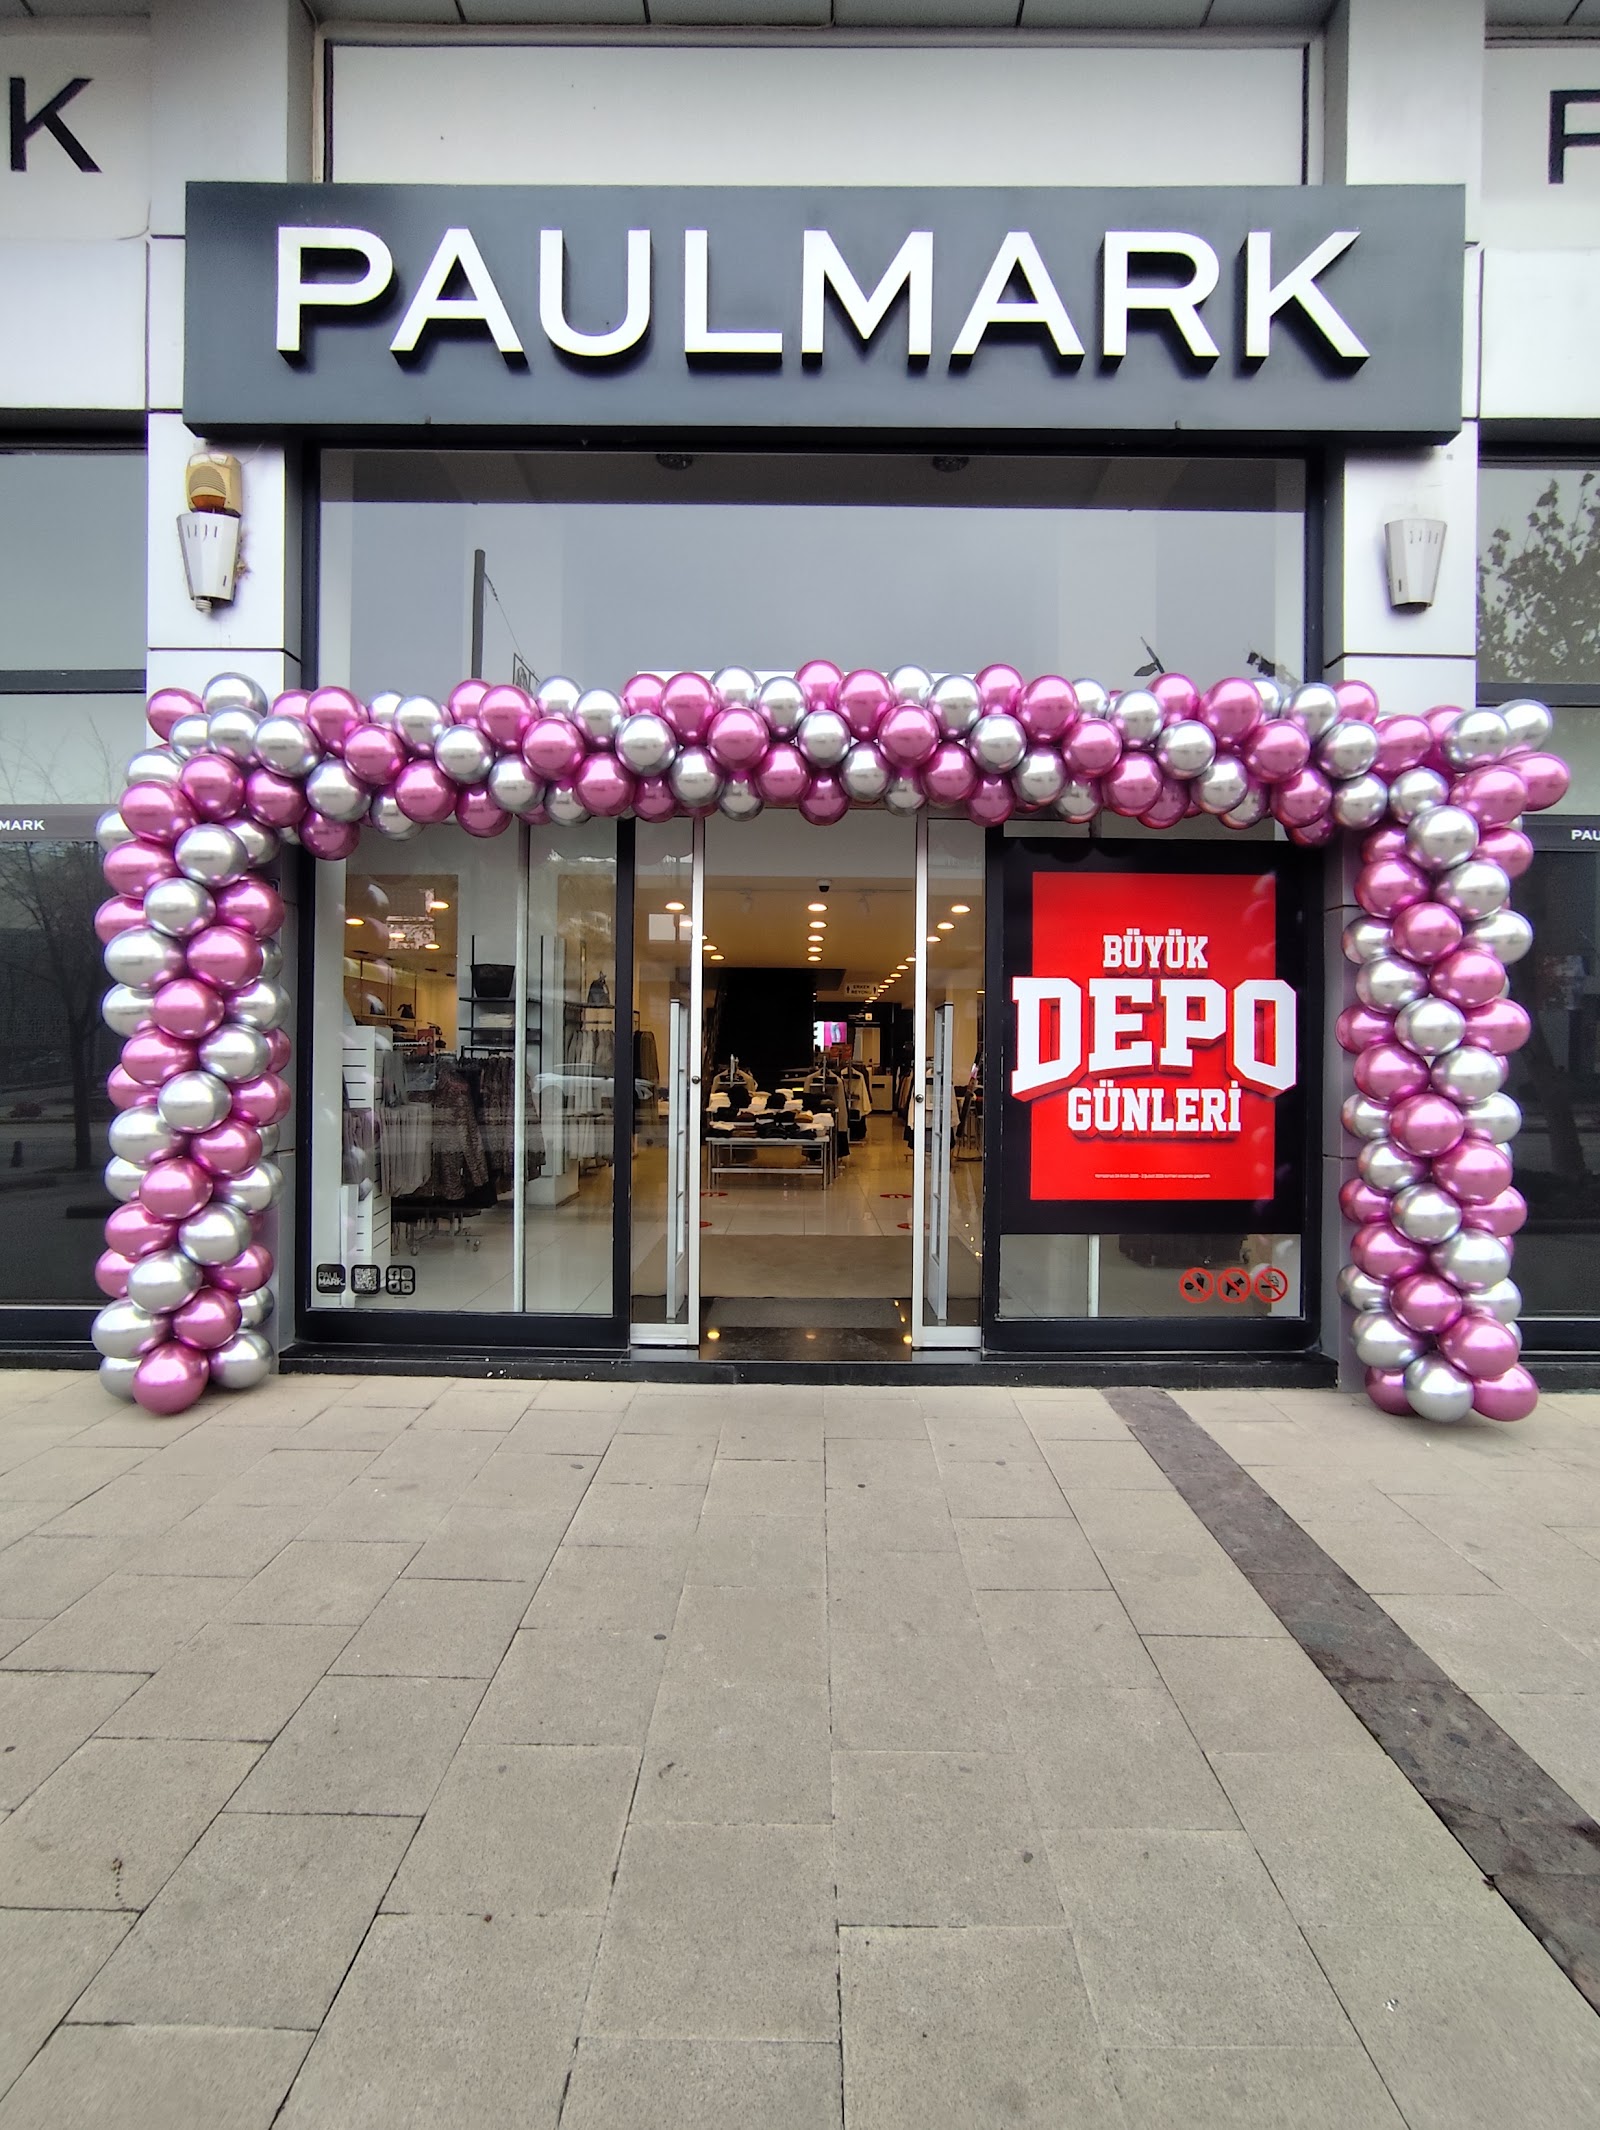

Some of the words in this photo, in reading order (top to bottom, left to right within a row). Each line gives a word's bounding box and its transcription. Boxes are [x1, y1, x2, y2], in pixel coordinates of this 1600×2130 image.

[9, 76, 102, 174] K
[275, 225, 1371, 372] PAULMARK
[0, 820, 46, 831] MARK
[1102, 928, 1209, 969] BÜYÜK
[1011, 976, 1297, 1096] DEPO
[1067, 1080, 1242, 1132] GÜNLERİ
